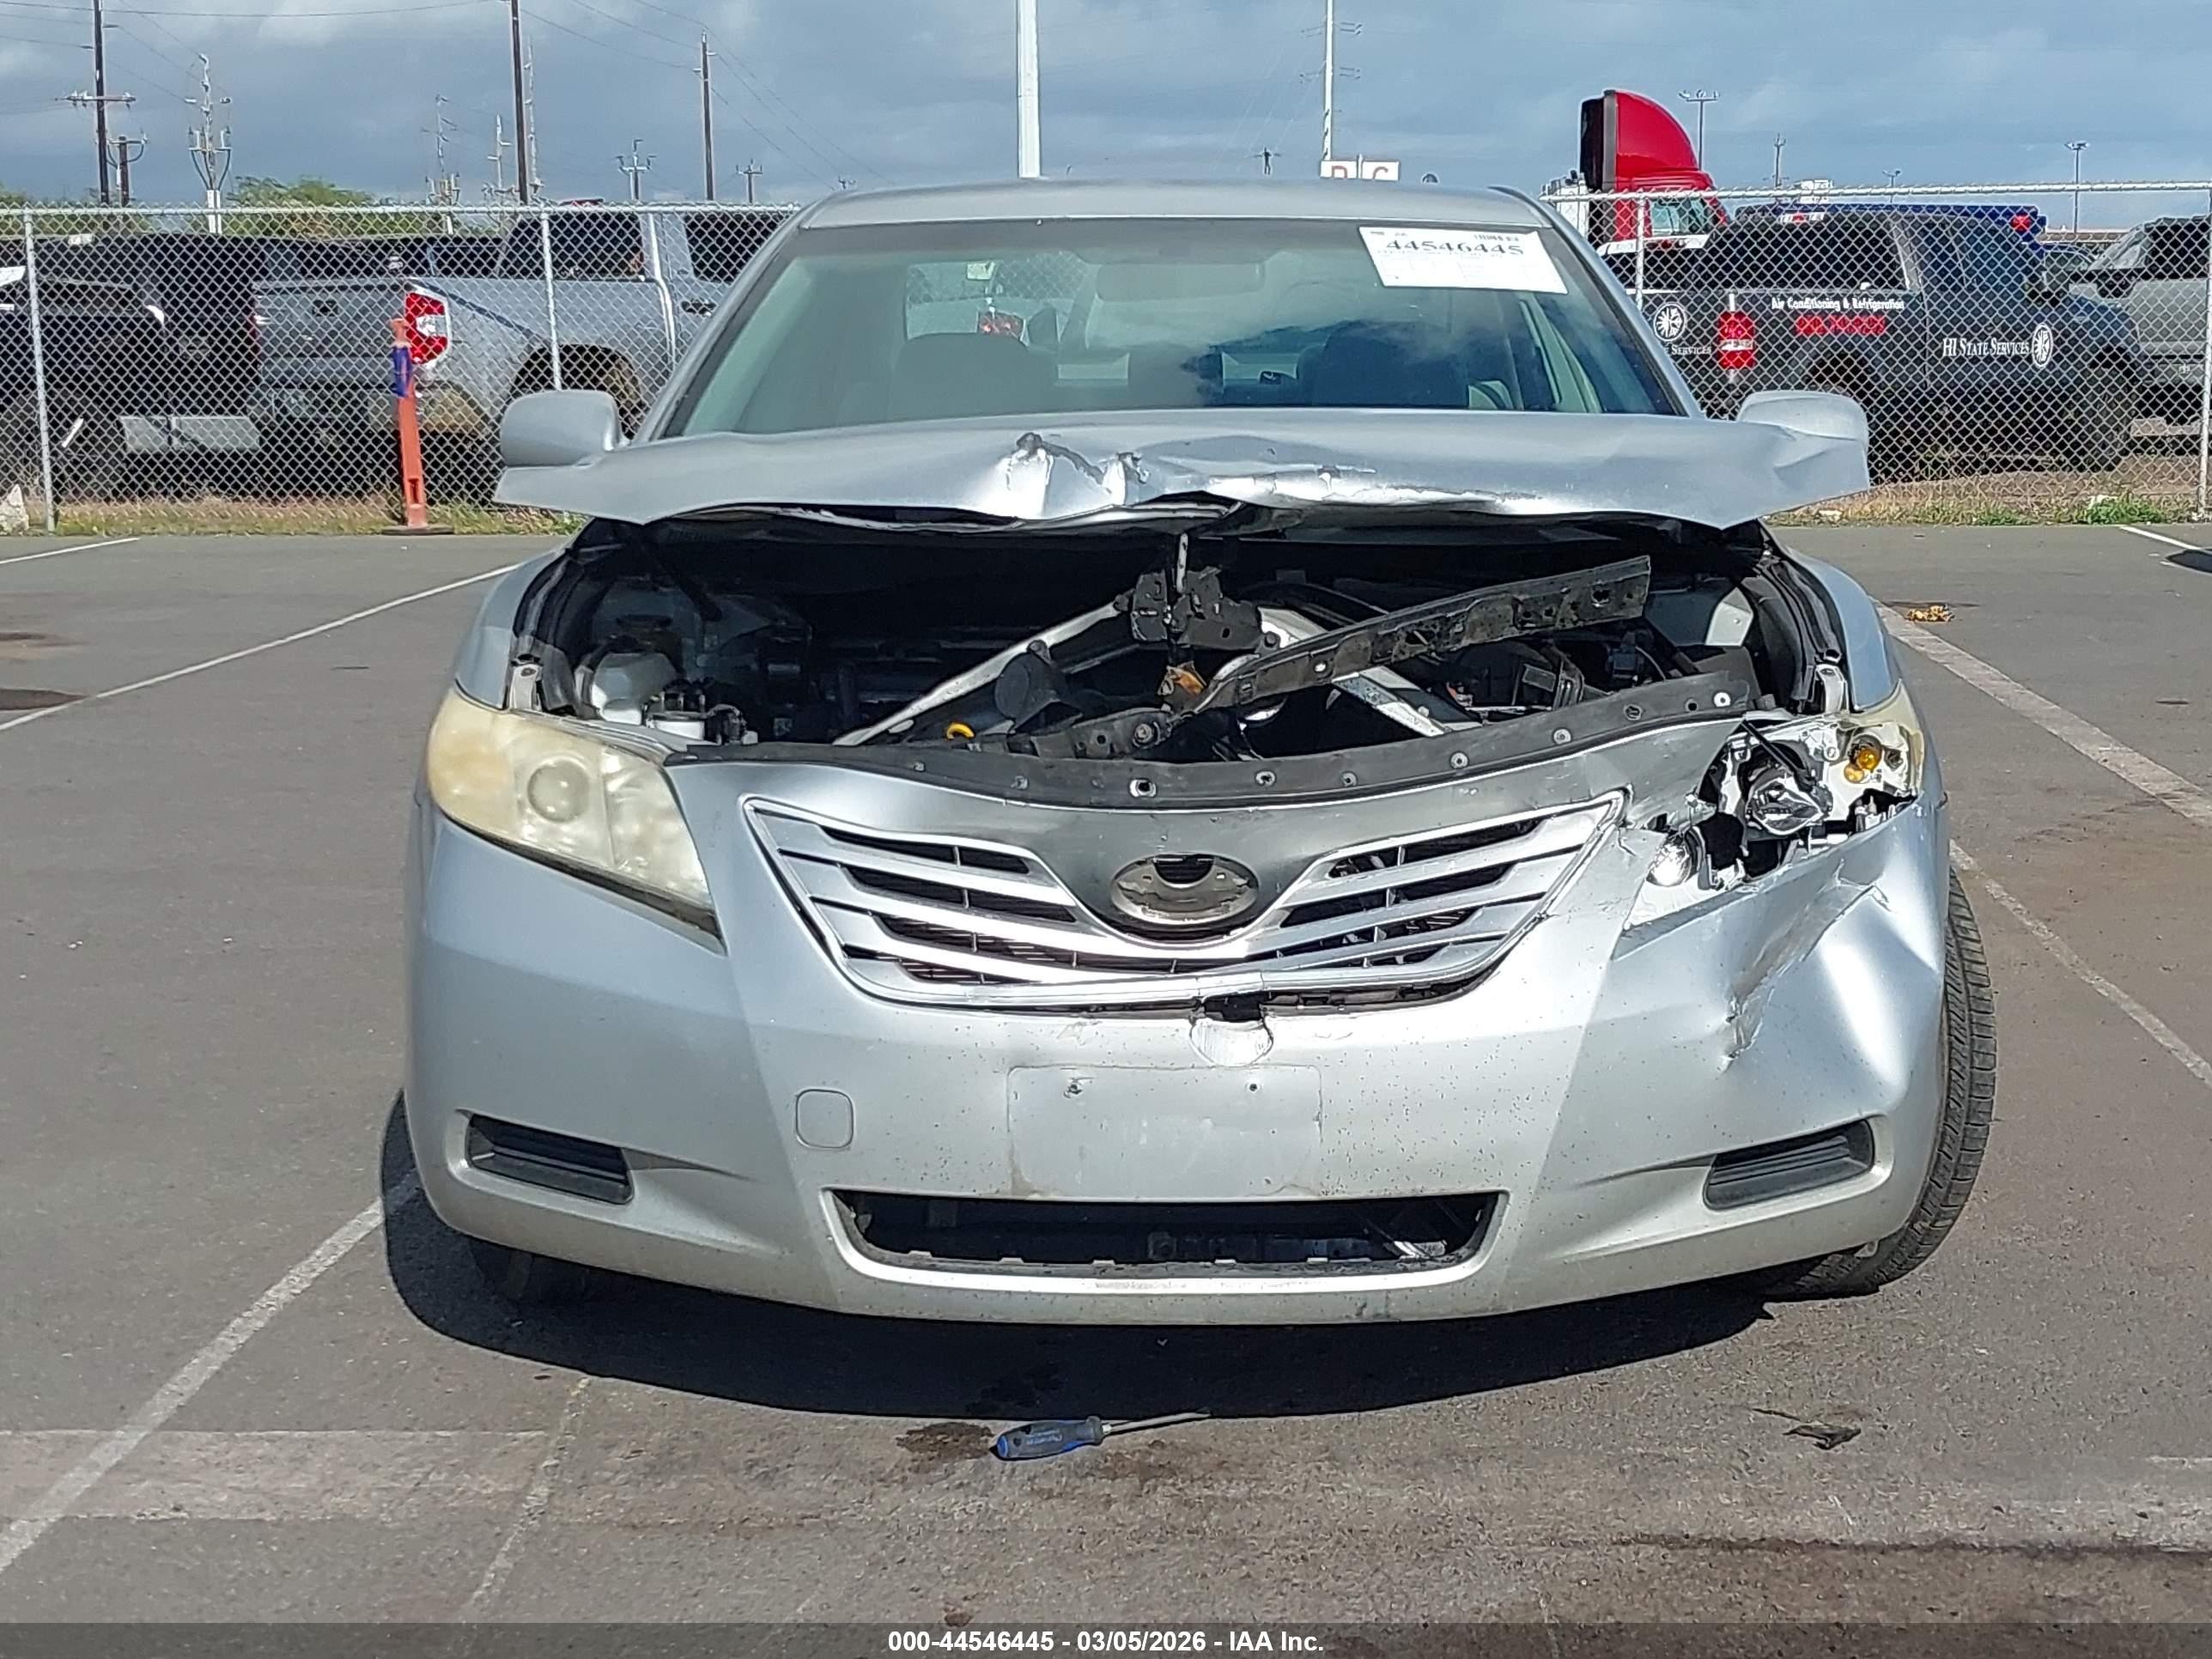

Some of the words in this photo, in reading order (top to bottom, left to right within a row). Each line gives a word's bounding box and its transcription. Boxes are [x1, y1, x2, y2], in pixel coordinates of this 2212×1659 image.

[1386, 239, 1524, 255] 44546445
[1771, 297, 1784, 310] Air
[1788, 297, 1841, 311] Conditioning
[1942, 337, 1957, 356] HI
